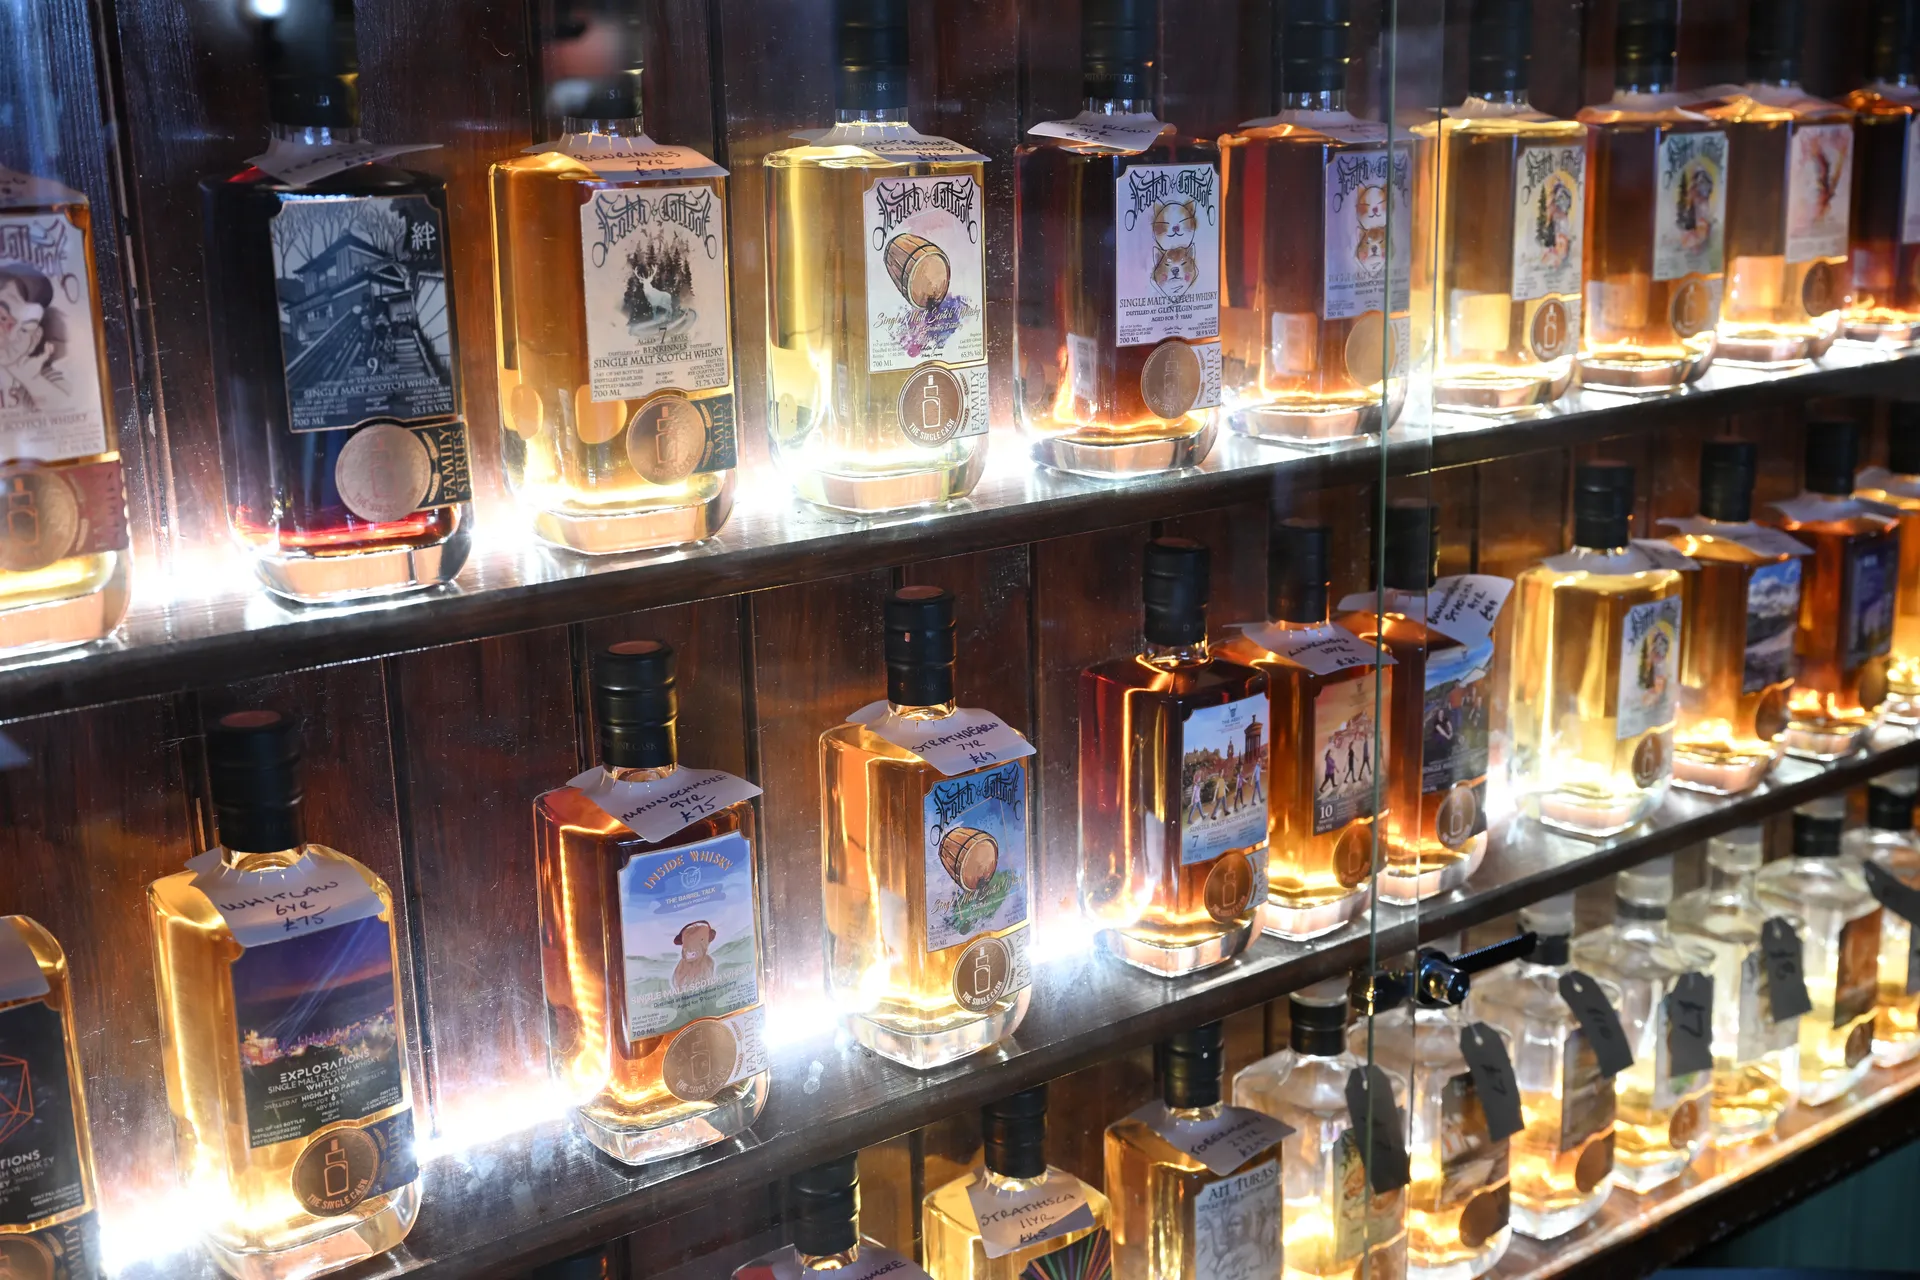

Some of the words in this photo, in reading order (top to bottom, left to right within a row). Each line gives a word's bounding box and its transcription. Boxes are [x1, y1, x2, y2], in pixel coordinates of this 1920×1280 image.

[628, 158, 675, 166] 7YR
[1119, 297, 1146, 308] SINGLE
[1147, 295, 1167, 306] MALT
[1195, 290, 1218, 302] WHISKY
[658, 326, 668, 344] 7
[367, 356, 379, 376] 9
[593, 357, 628, 369] SINGLE
[630, 355, 654, 366] MALT
[656, 351, 692, 364] SCOTCH
[693, 346, 724, 360] WHISKY
[303, 387, 338, 399] SINGLE
[340, 384, 366, 396] MALT
[367, 380, 406, 392] SCOTCH
[406, 376, 440, 388] WHISKY
[593, 390, 609, 398] 700
[609, 389, 622, 397] ML
[970, 370, 980, 431] FAMILY
[909, 422, 921, 437] THE
[920, 430, 941, 441] SINGLE
[940, 418, 955, 437] CASK
[438, 429, 457, 500] FAMILY
[453, 430, 468, 493] SERIES
[911, 721, 999, 753] STRATHDEARN
[956, 739, 986, 751] 7YR
[969, 751, 997, 765] £69
[621, 773, 728, 822] MANNOCHMORE
[669, 793, 708, 810] 9YR
[679, 795, 717, 823] £75
[1320, 804, 1333, 819] 10
[1192, 834, 1199, 848] 7
[643, 854, 685, 890] INSIDE
[689, 850, 734, 872] WHISKY
[219, 880, 339, 912] WHITLAW
[664, 897, 679, 905] THE
[679, 890, 701, 903] BARREL
[701, 886, 717, 896] TALK
[275, 901, 316, 916] 6YR
[282, 906, 332, 932] £75
[631, 991, 662, 1005] SINGLE
[688, 976, 722, 992] SCOTCH
[962, 991, 973, 1004] THE
[971, 993, 991, 1006] SINGLE
[990, 980, 1003, 998] CASK
[677, 1001, 691, 1010] Aged
[646, 1028, 657, 1036] ML
[744, 1016, 758, 1075] FAMILY
[268, 1081, 297, 1095] SINGLE
[297, 1074, 321, 1087] MALT
[320, 1064, 352, 1080] SCOTCH
[353, 1055, 381, 1071] WHISKY
[279, 1050, 370, 1084] EXPLORATIONS
[301, 1085, 340, 1102] HIGHLAND
[340, 1079, 360, 1091] PARK
[306, 1074, 348, 1092] WHITLAW
[307, 1193, 322, 1208] THE
[321, 1199, 351, 1210] SINGLE
[350, 1178, 369, 1201] CASK
